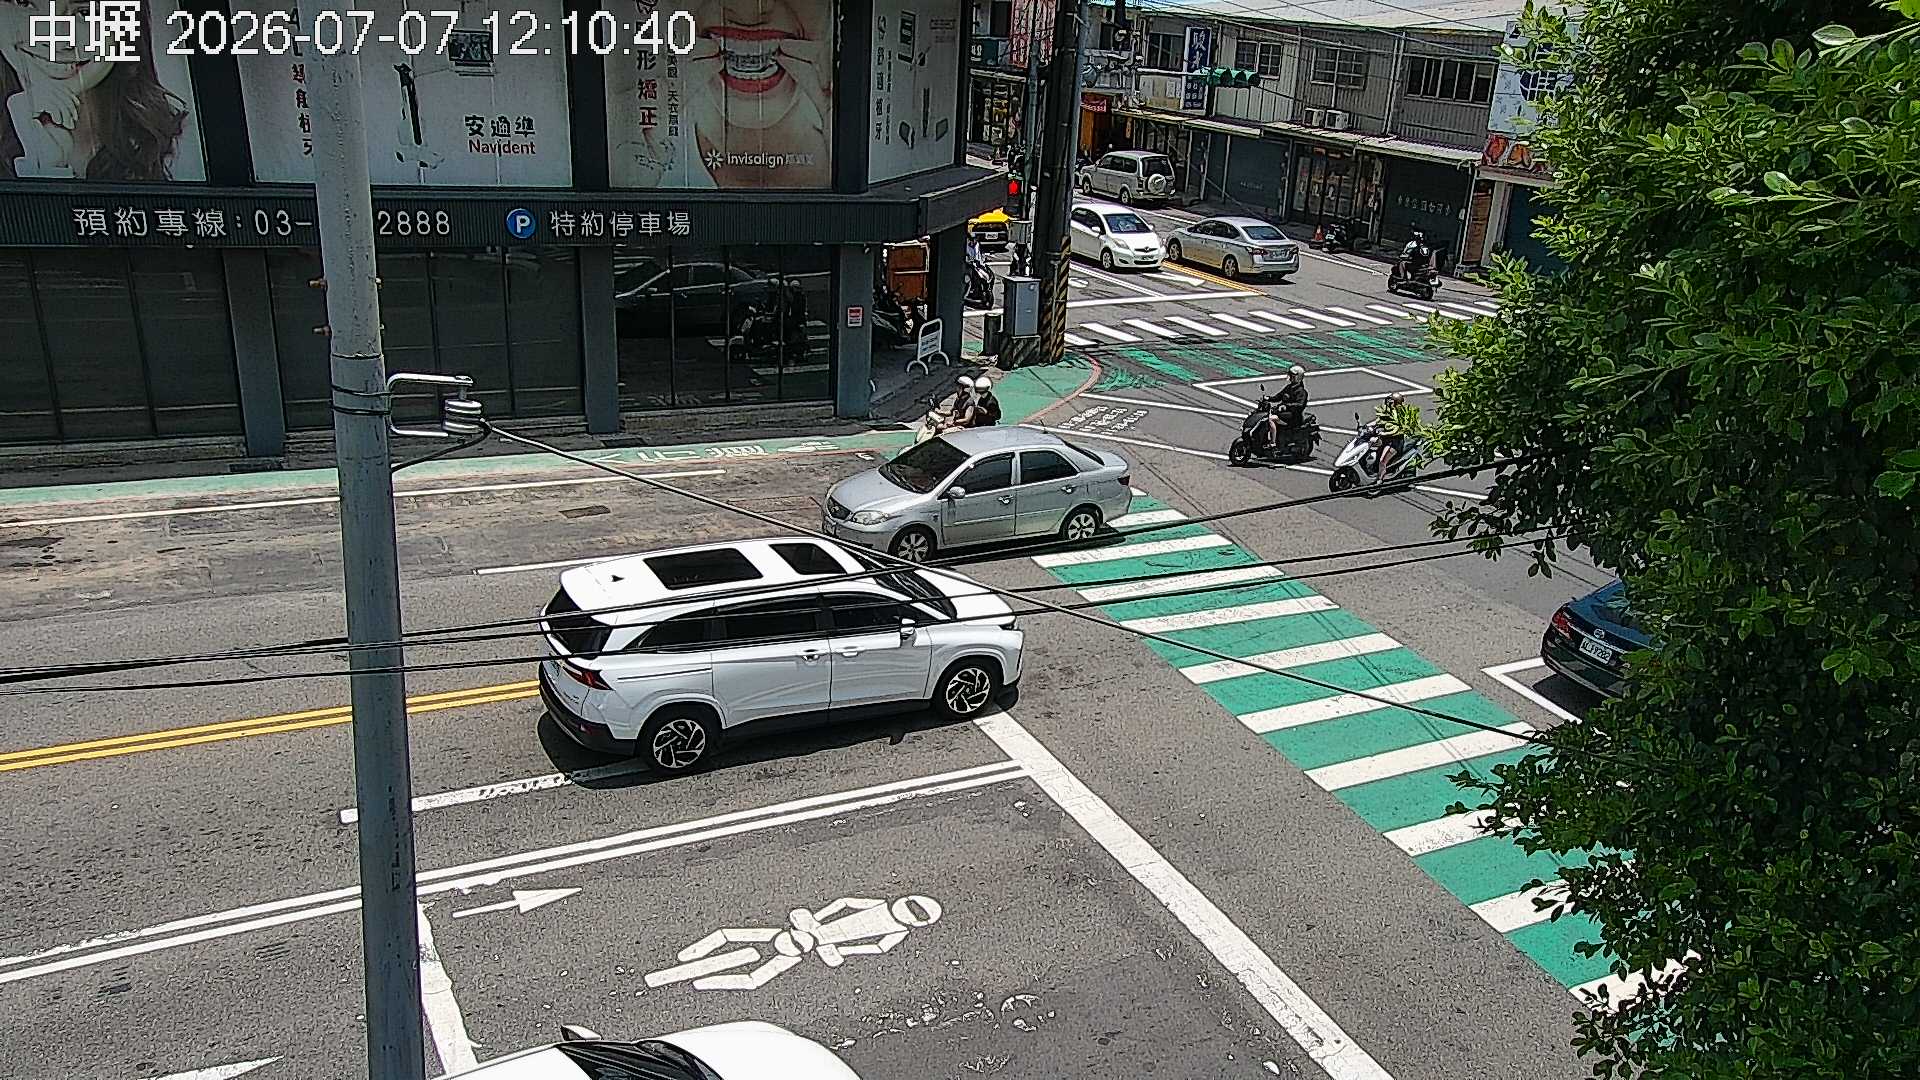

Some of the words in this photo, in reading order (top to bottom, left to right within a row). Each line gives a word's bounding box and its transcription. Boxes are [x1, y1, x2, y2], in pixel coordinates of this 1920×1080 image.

[469, 138, 536, 156] Navident
[549, 209, 692, 238] 特約停車場
